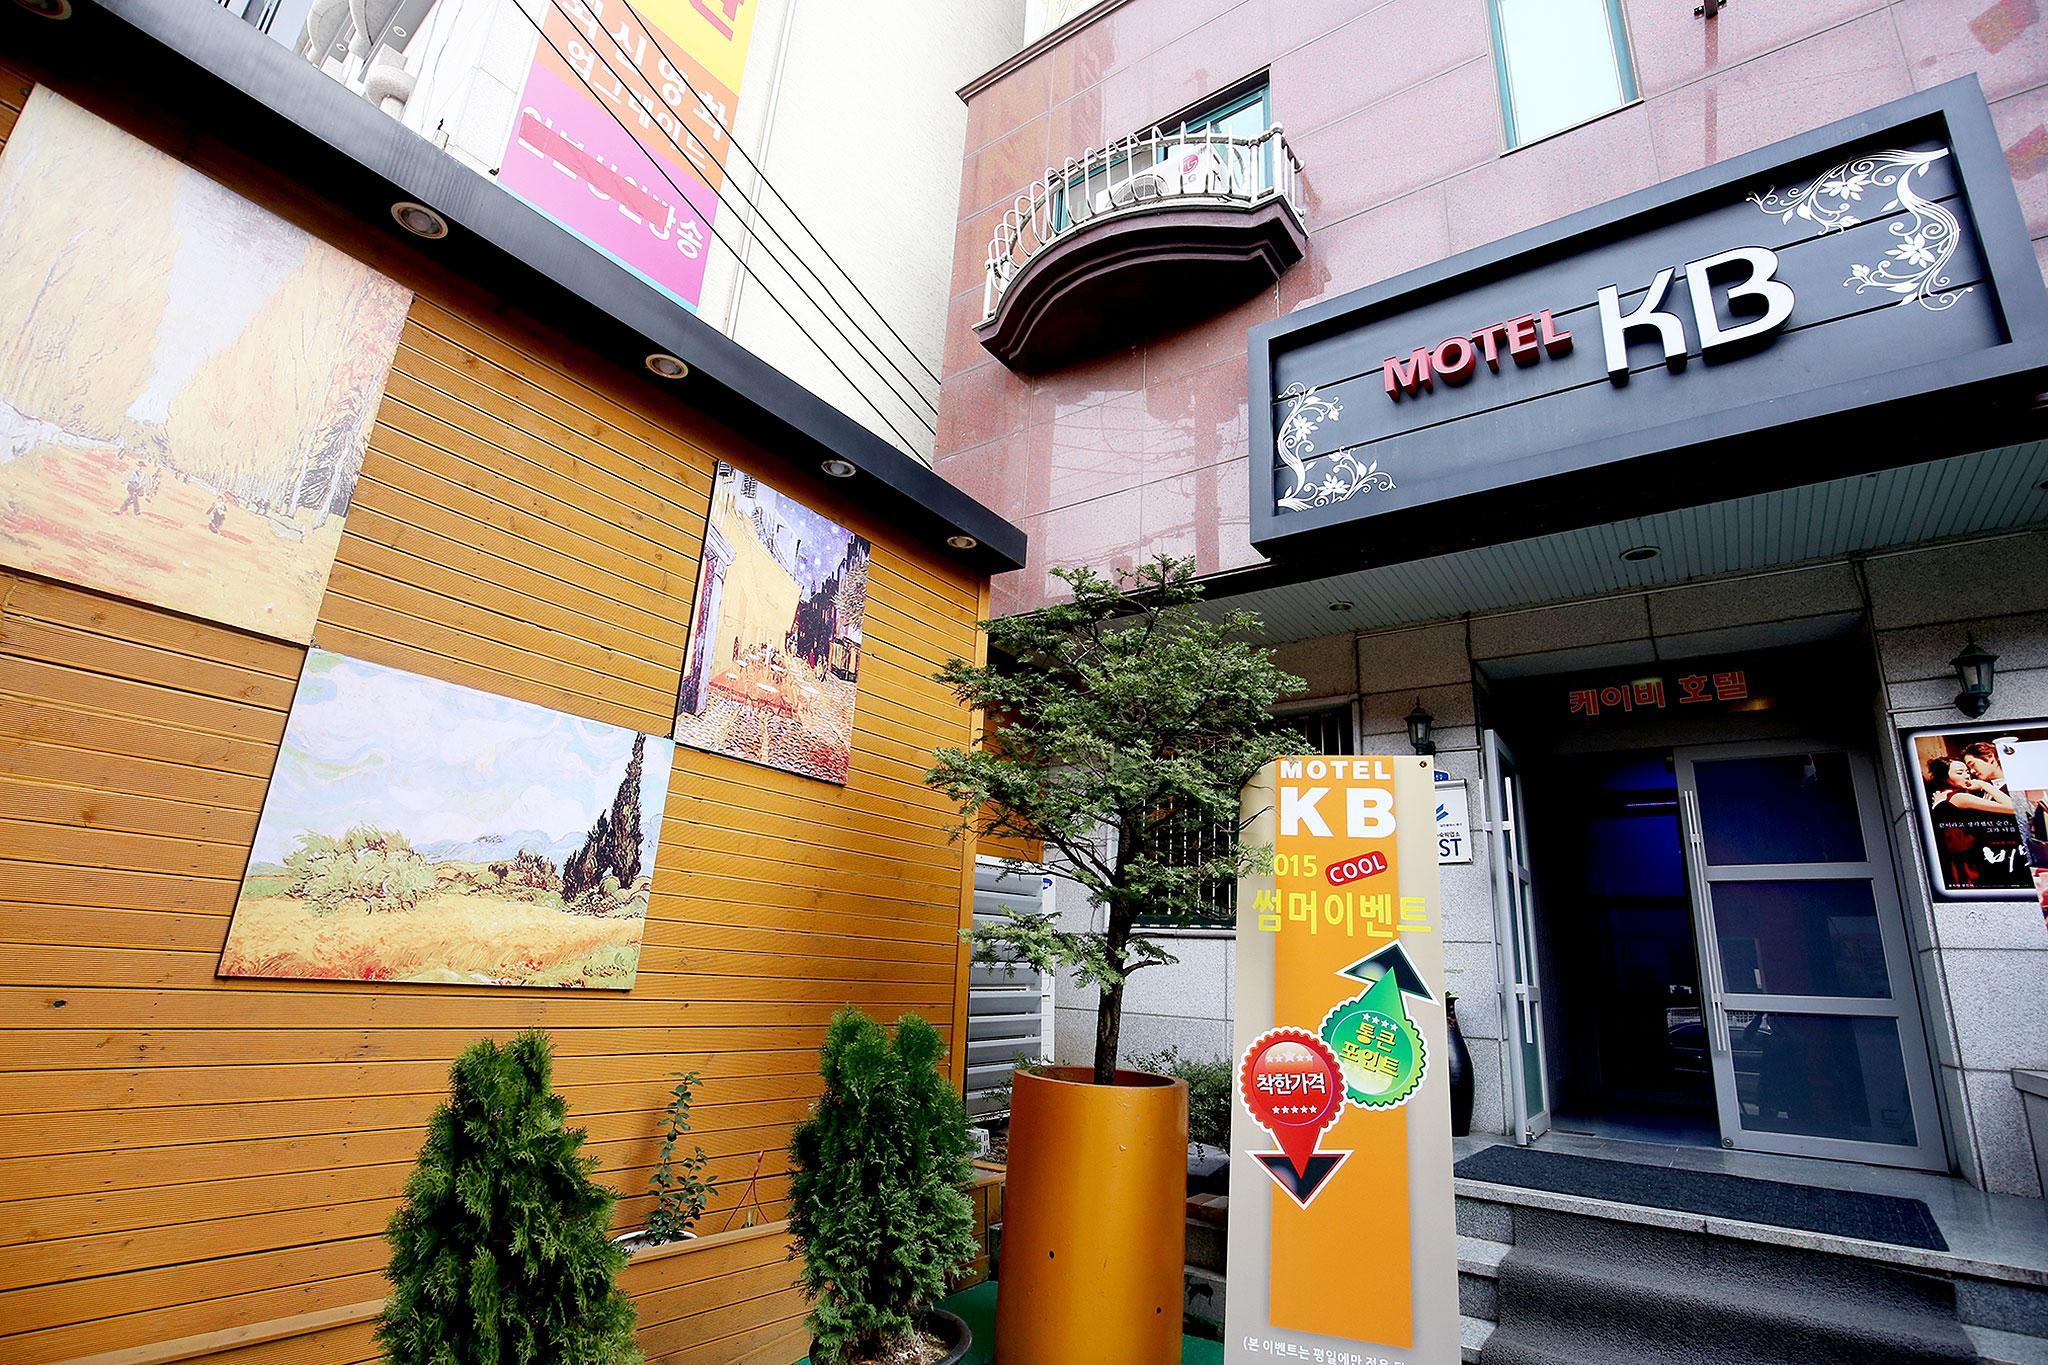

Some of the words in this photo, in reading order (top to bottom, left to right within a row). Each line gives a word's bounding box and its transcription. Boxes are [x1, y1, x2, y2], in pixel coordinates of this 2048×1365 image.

[567, 41, 706, 171] 업그레이드
[1383, 309, 1574, 401] MOTEL
[1597, 245, 1795, 387] KB
[1569, 677, 1666, 716] 케이비
[1678, 670, 1748, 704] 호텔
[1280, 760, 1392, 780] MOTEL
[1280, 786, 1397, 839] KB
[1262, 853, 1318, 877] 015
[1328, 855, 1386, 883] COOL
[1252, 888, 1431, 938] 썸머이벤트
[1356, 1022, 1397, 1053] 통큰
[1339, 1041, 1400, 1078] 포인트
[1256, 1072, 1327, 1096] 착한가격
[1243, 1335, 1260, 1352] (본
[1263, 1339, 1311, 1361] 이벤트는
[1312, 1347, 1363, 1365] 평일에만
